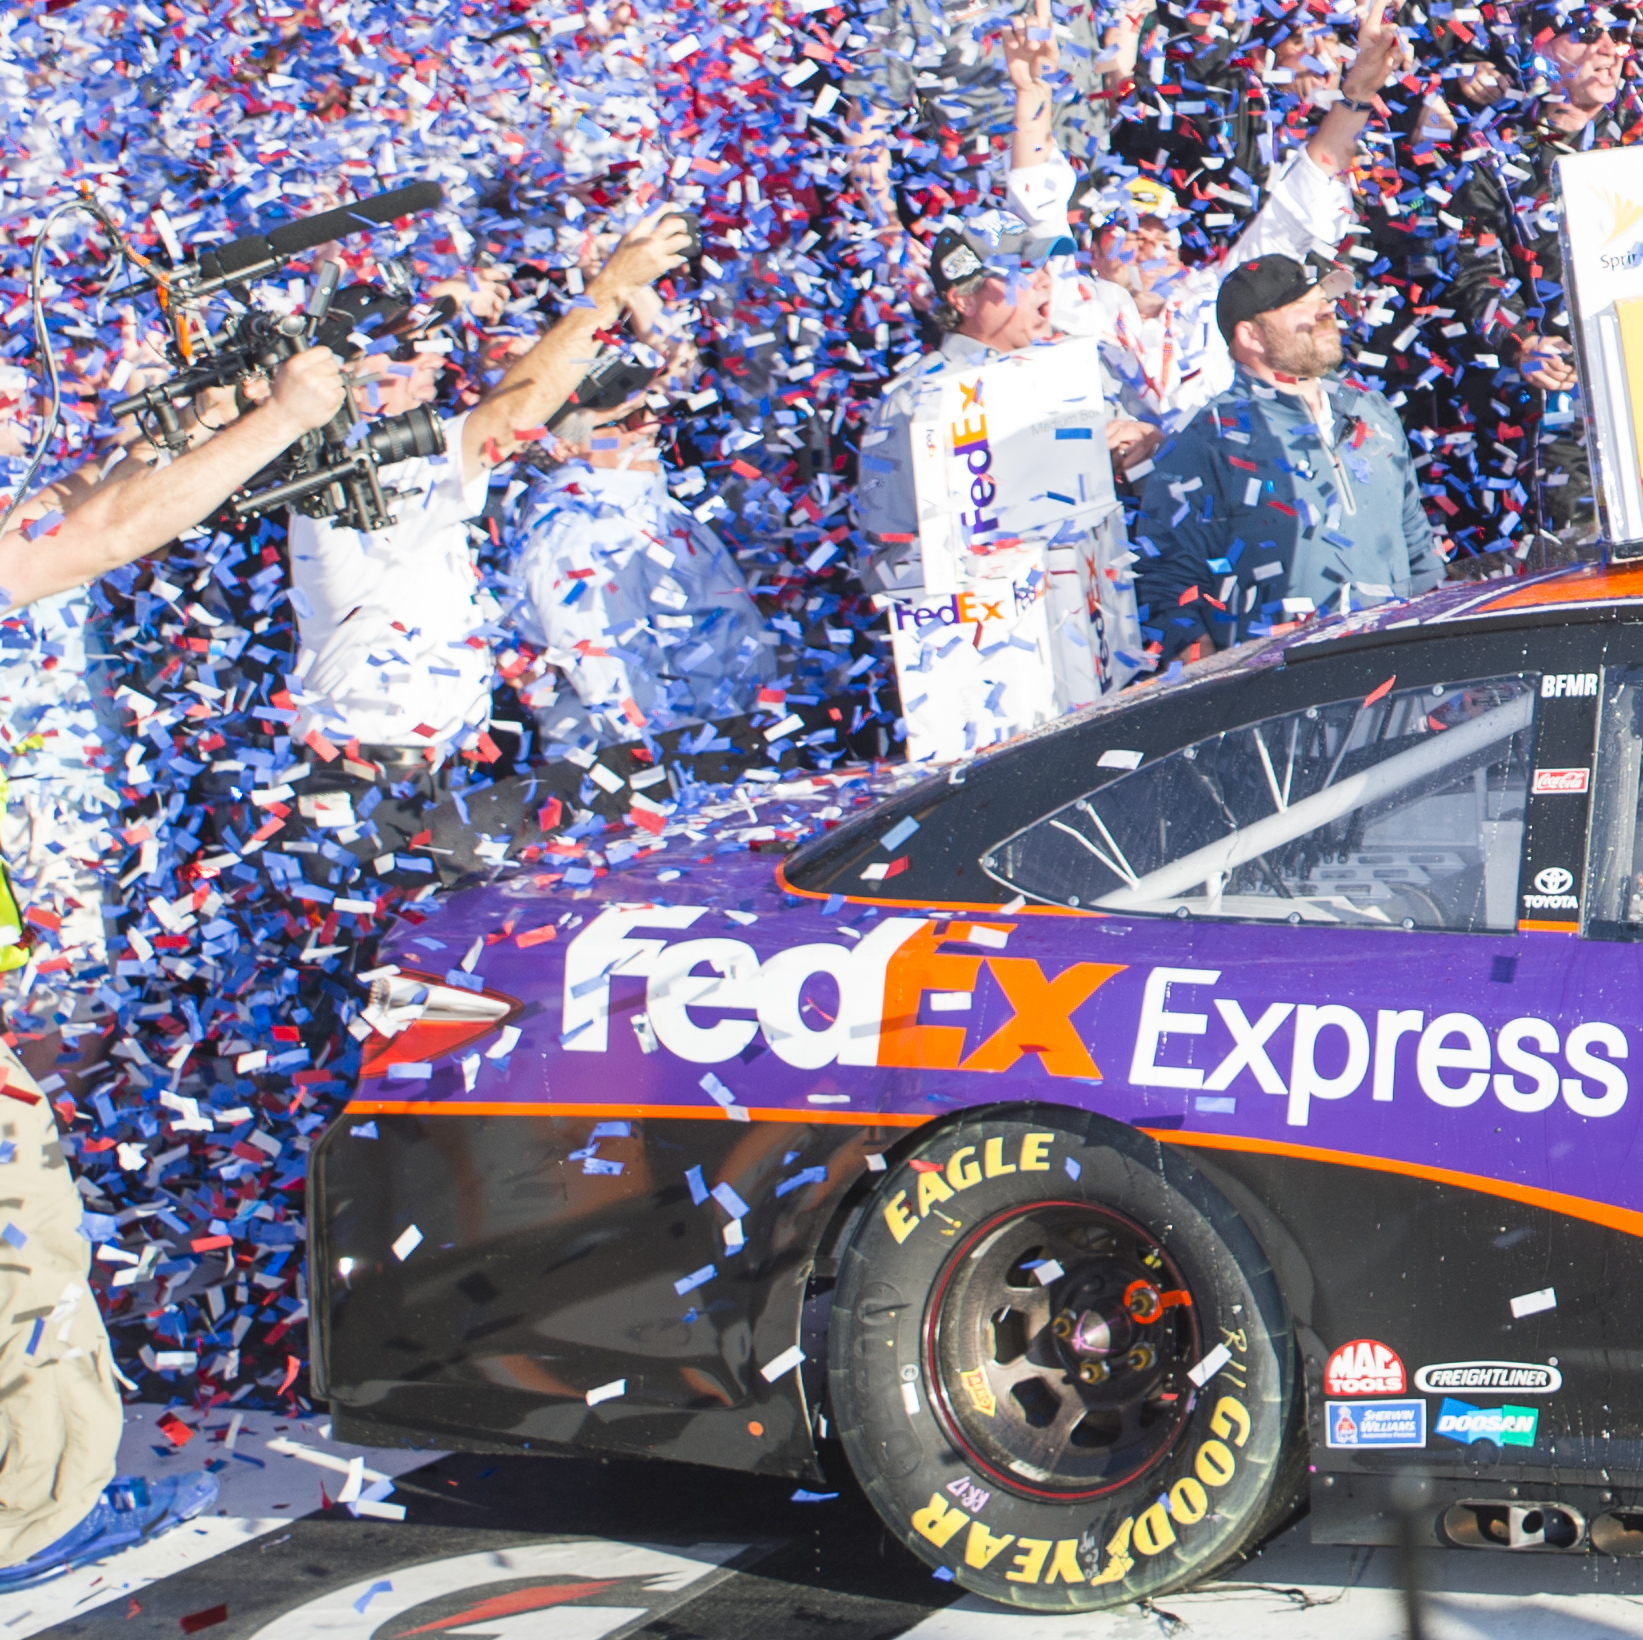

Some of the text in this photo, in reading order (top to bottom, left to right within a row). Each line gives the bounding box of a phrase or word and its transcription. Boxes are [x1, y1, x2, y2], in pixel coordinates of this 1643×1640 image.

[952, 376, 1000, 535] FedEx
[894, 591, 1006, 631] FedEx
[1541, 673, 1598, 698] BFMR
[1523, 894, 1579, 910] TOYOTA
[561, 901, 1130, 1080] FedEx
[1128, 966, 1630, 1127] Express
[884, 1132, 1056, 1245] EAGLE
[1329, 1341, 1402, 1379] MAC
[1329, 1377, 1403, 1394] TOOLS
[1429, 1367, 1548, 1388] FREIGHTLINER
[1360, 1421, 1417, 1433] WILLIAMS
[1363, 1409, 1416, 1421] SHERWIN
[1437, 1415, 1536, 1433] DOOSAN
[912, 1394, 1253, 1586] GOODYEAR
